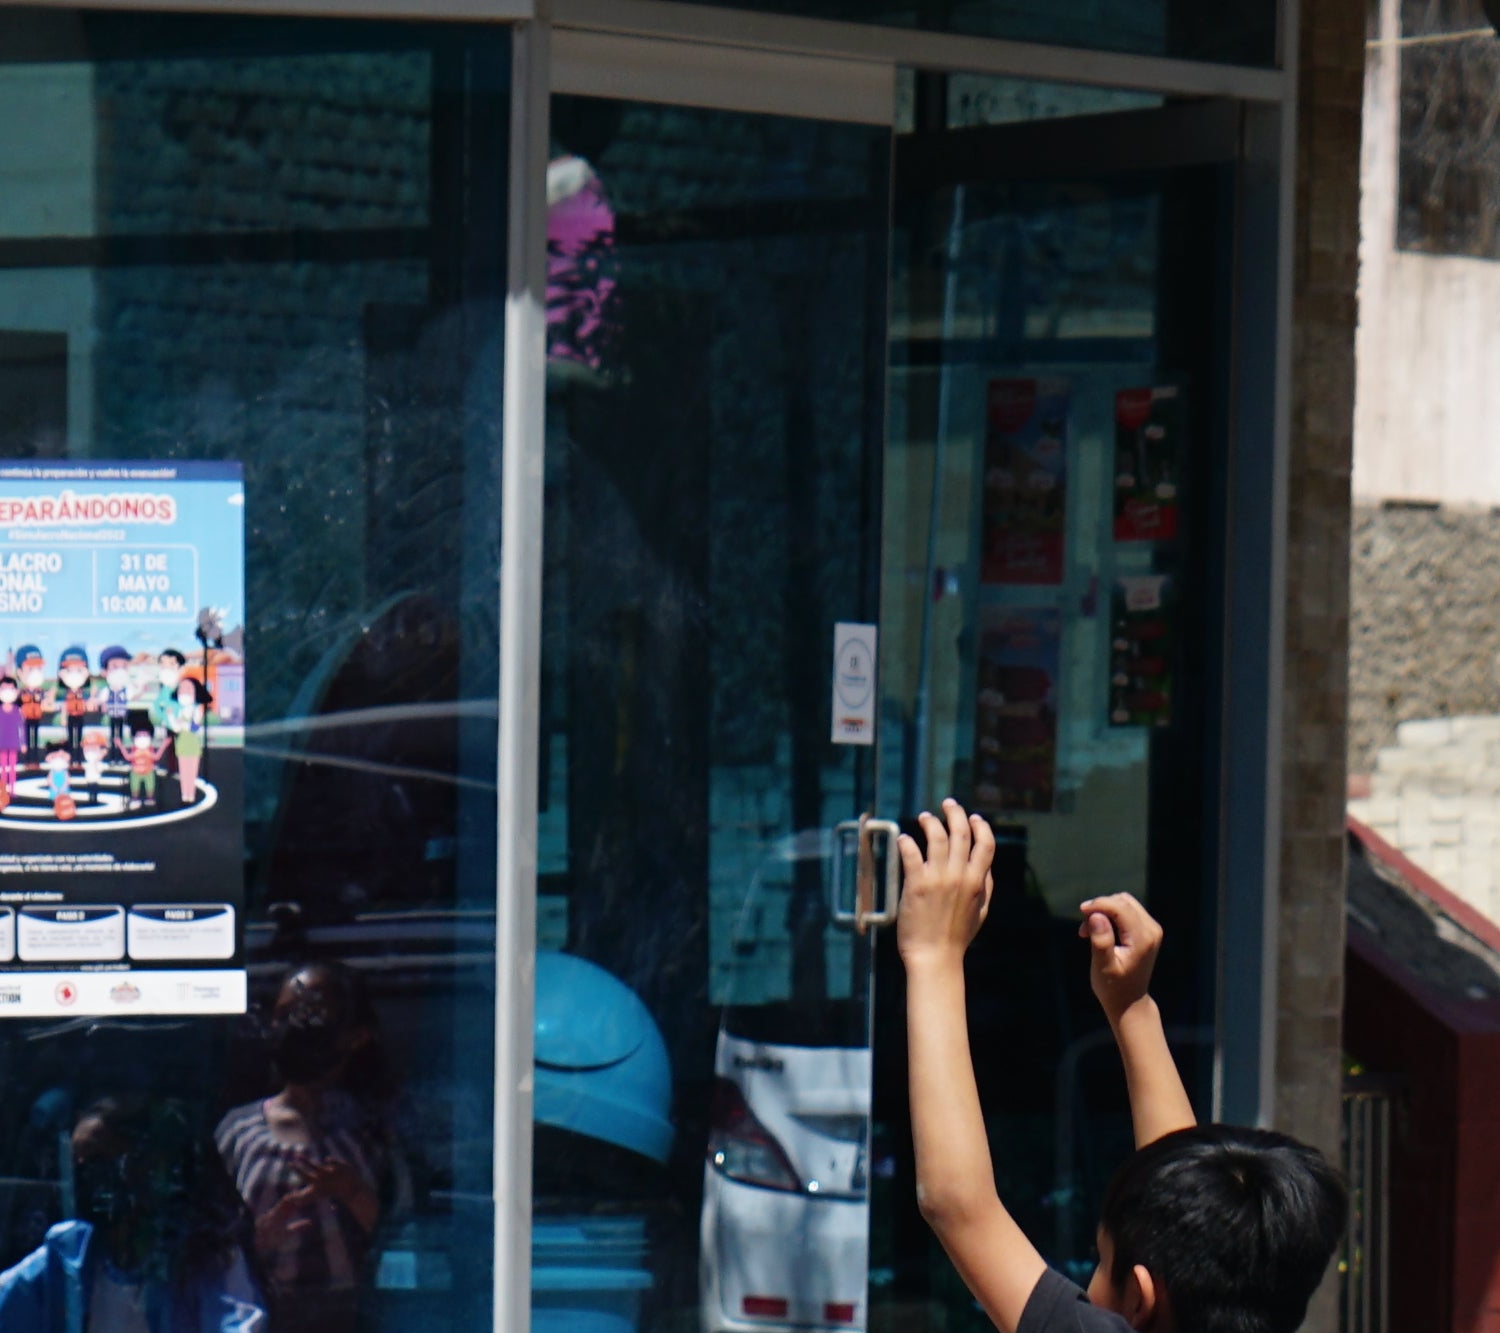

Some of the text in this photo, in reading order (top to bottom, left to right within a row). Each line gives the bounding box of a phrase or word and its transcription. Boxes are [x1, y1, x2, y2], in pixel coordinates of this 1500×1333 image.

[120, 554, 168, 571] 31 DE
[118, 575, 170, 592] MAYO
[101, 595, 188, 612] 10:00 A.M.
